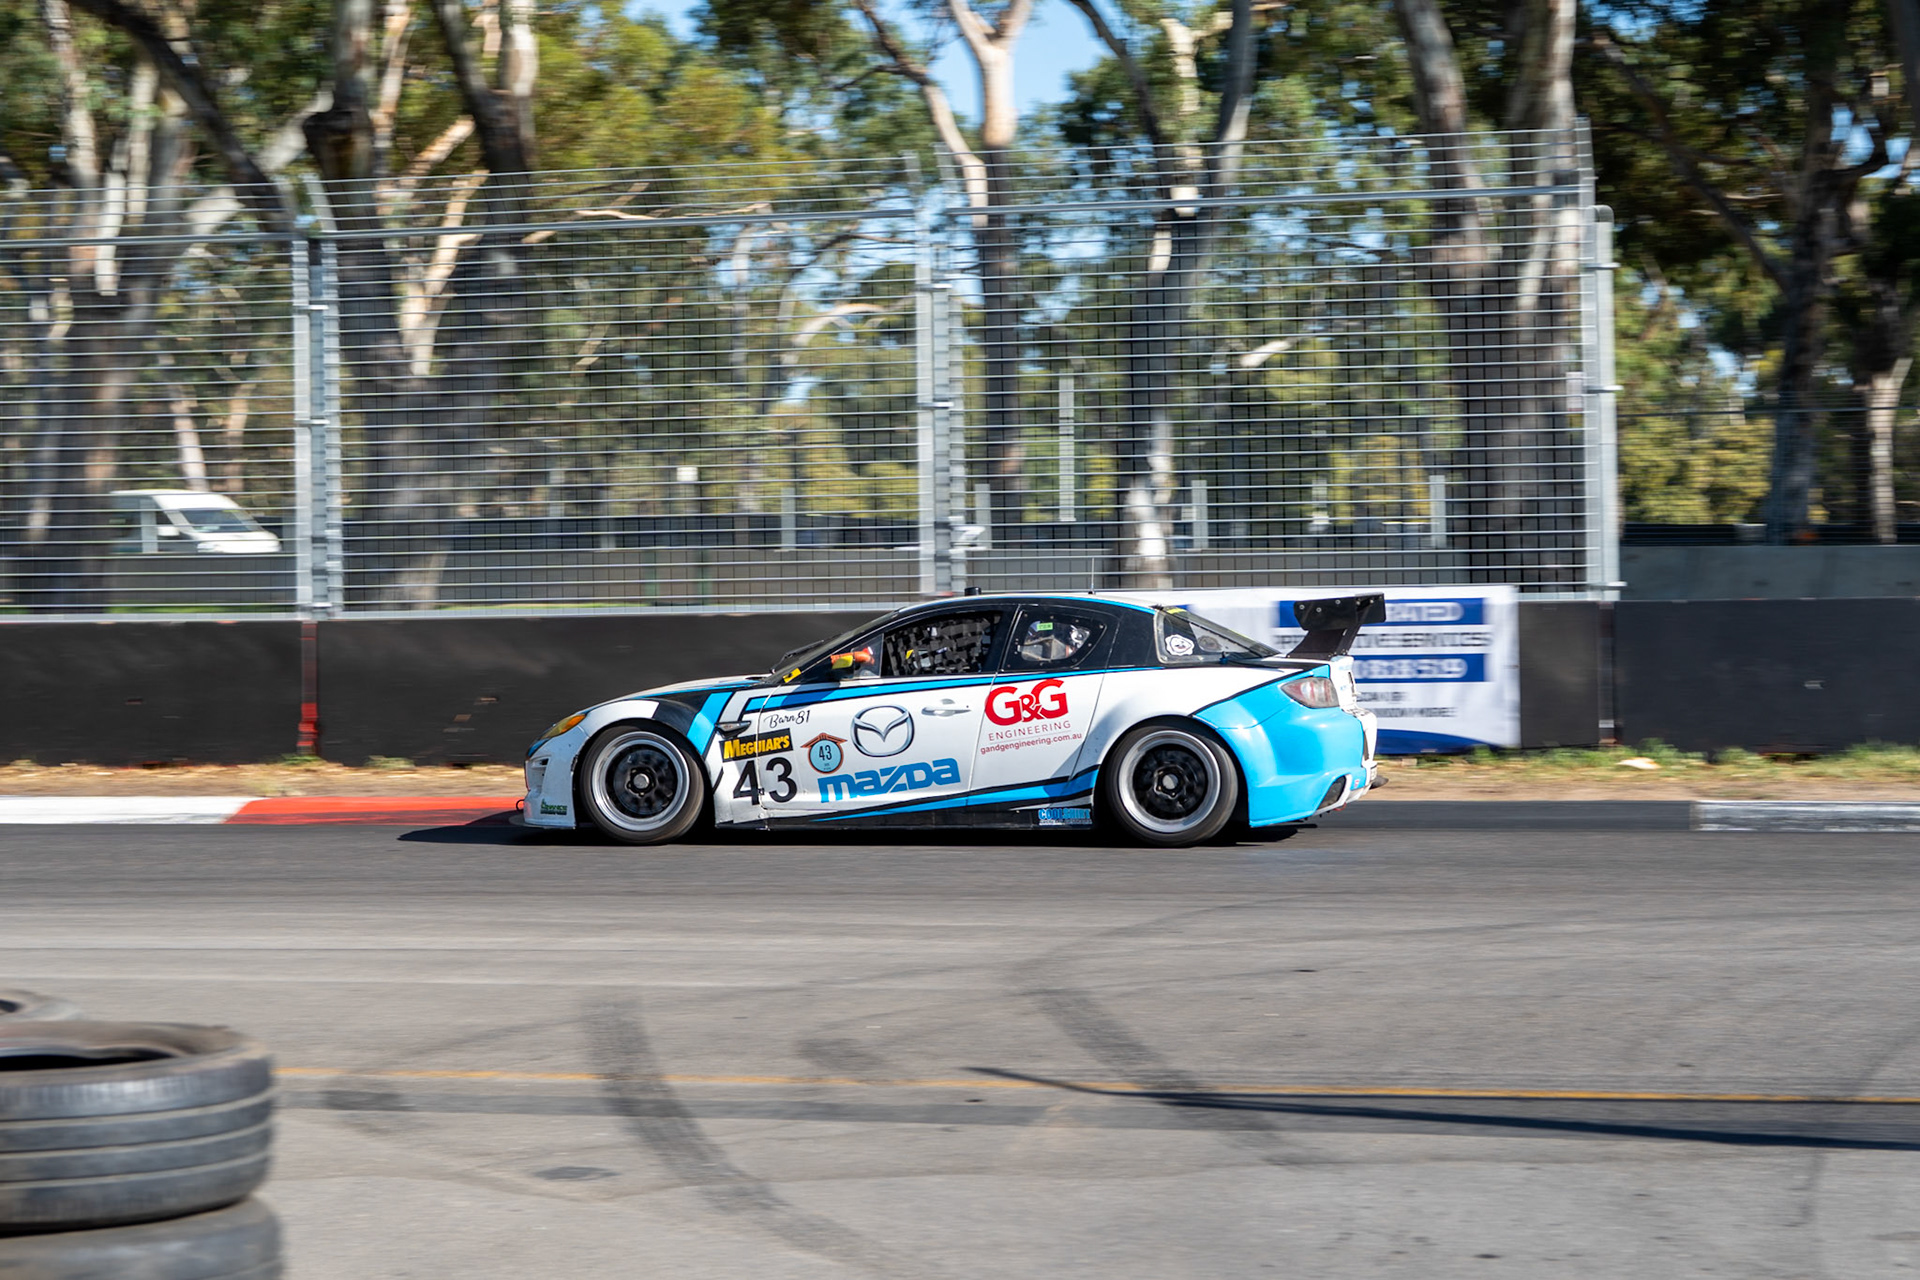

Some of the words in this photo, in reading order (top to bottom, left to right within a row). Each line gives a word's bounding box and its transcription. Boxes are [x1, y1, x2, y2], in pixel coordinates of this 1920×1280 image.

[984, 678, 1069, 726] G&G
[988, 720, 1071, 742] ENGINEERING
[818, 744, 833, 761] 43
[980, 732, 1082, 755] gandgengineering.com.au
[733, 757, 798, 806] 43
